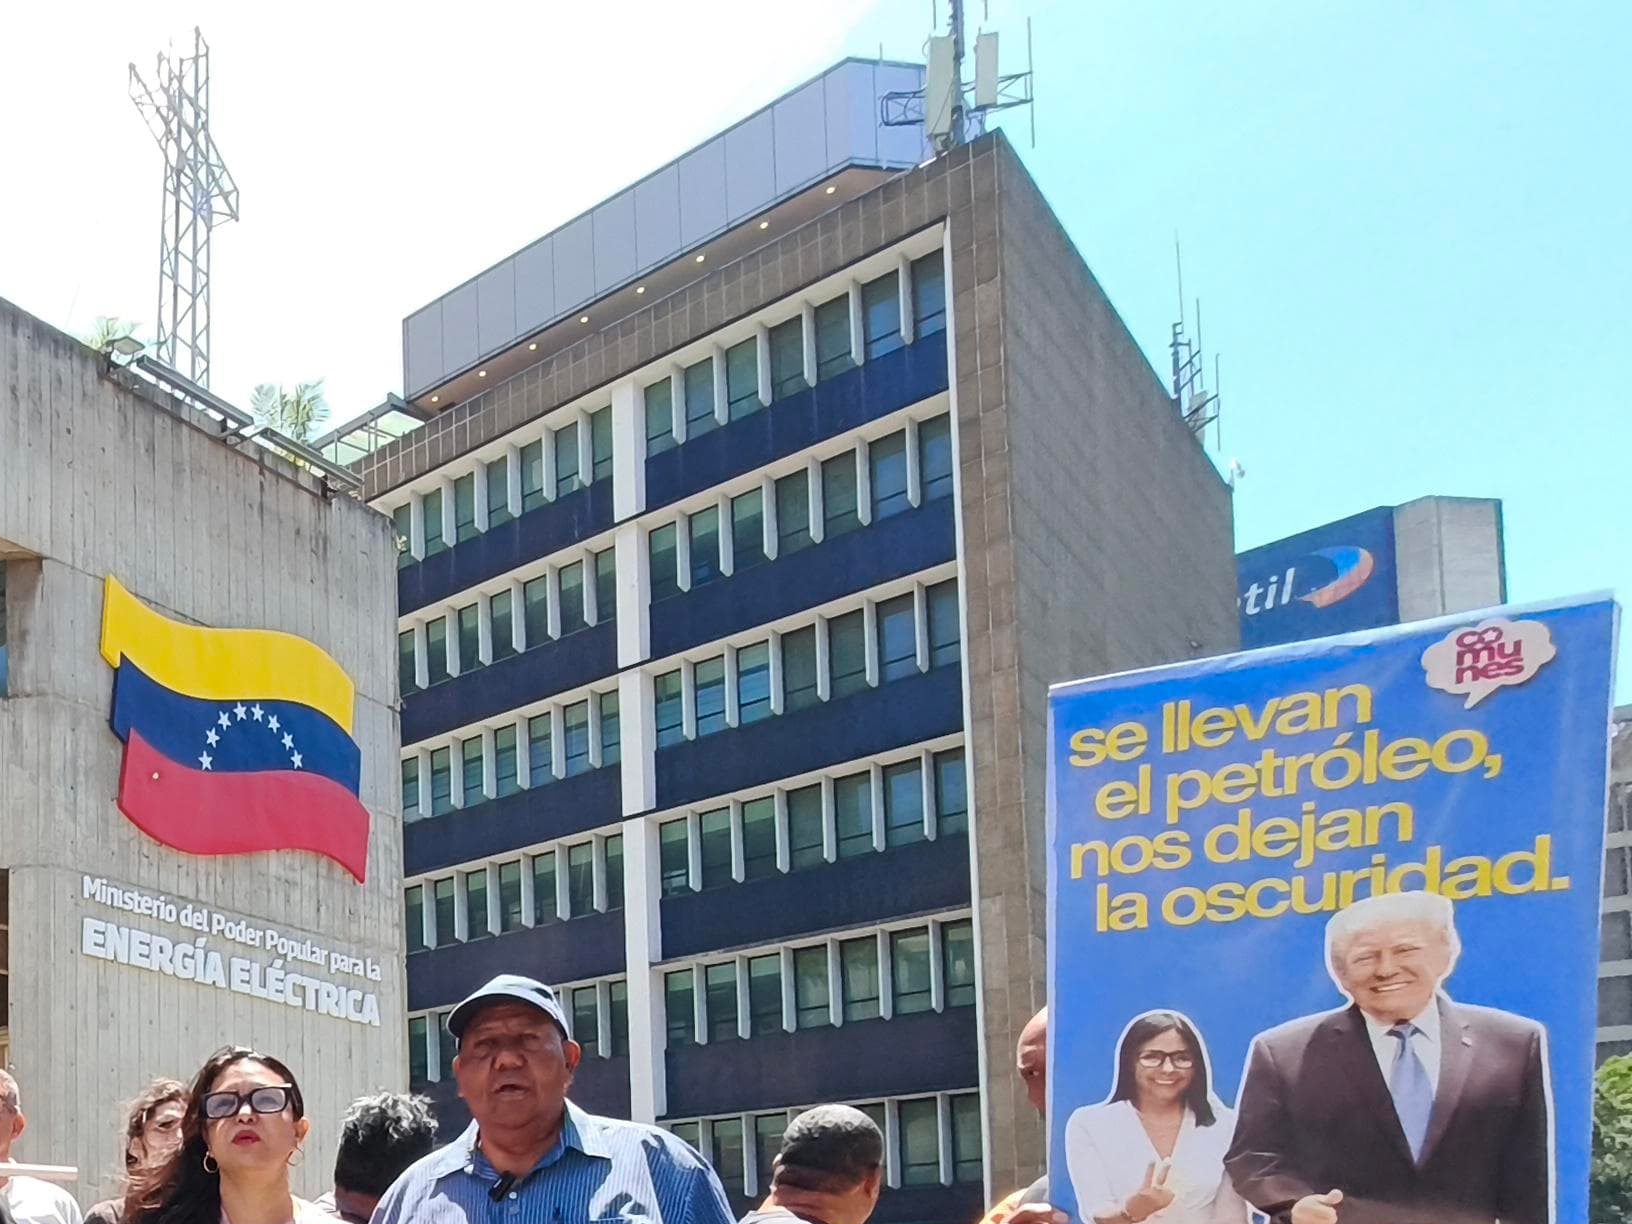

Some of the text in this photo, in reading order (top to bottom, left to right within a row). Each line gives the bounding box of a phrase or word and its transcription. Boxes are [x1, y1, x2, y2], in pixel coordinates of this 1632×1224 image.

[1237, 567, 1295, 615] til
[1455, 656, 1525, 685] nes
[1069, 682, 1371, 769] se llevan
[1095, 729, 1502, 824] el petróleo,
[1070, 801, 1414, 879] nos dejan
[1096, 834, 1571, 933] la oscuridad.
[82, 918, 381, 1027] ENERGÍA ELÉCTRICA
[83, 875, 382, 981] Ministerio del Poder Popular para la
